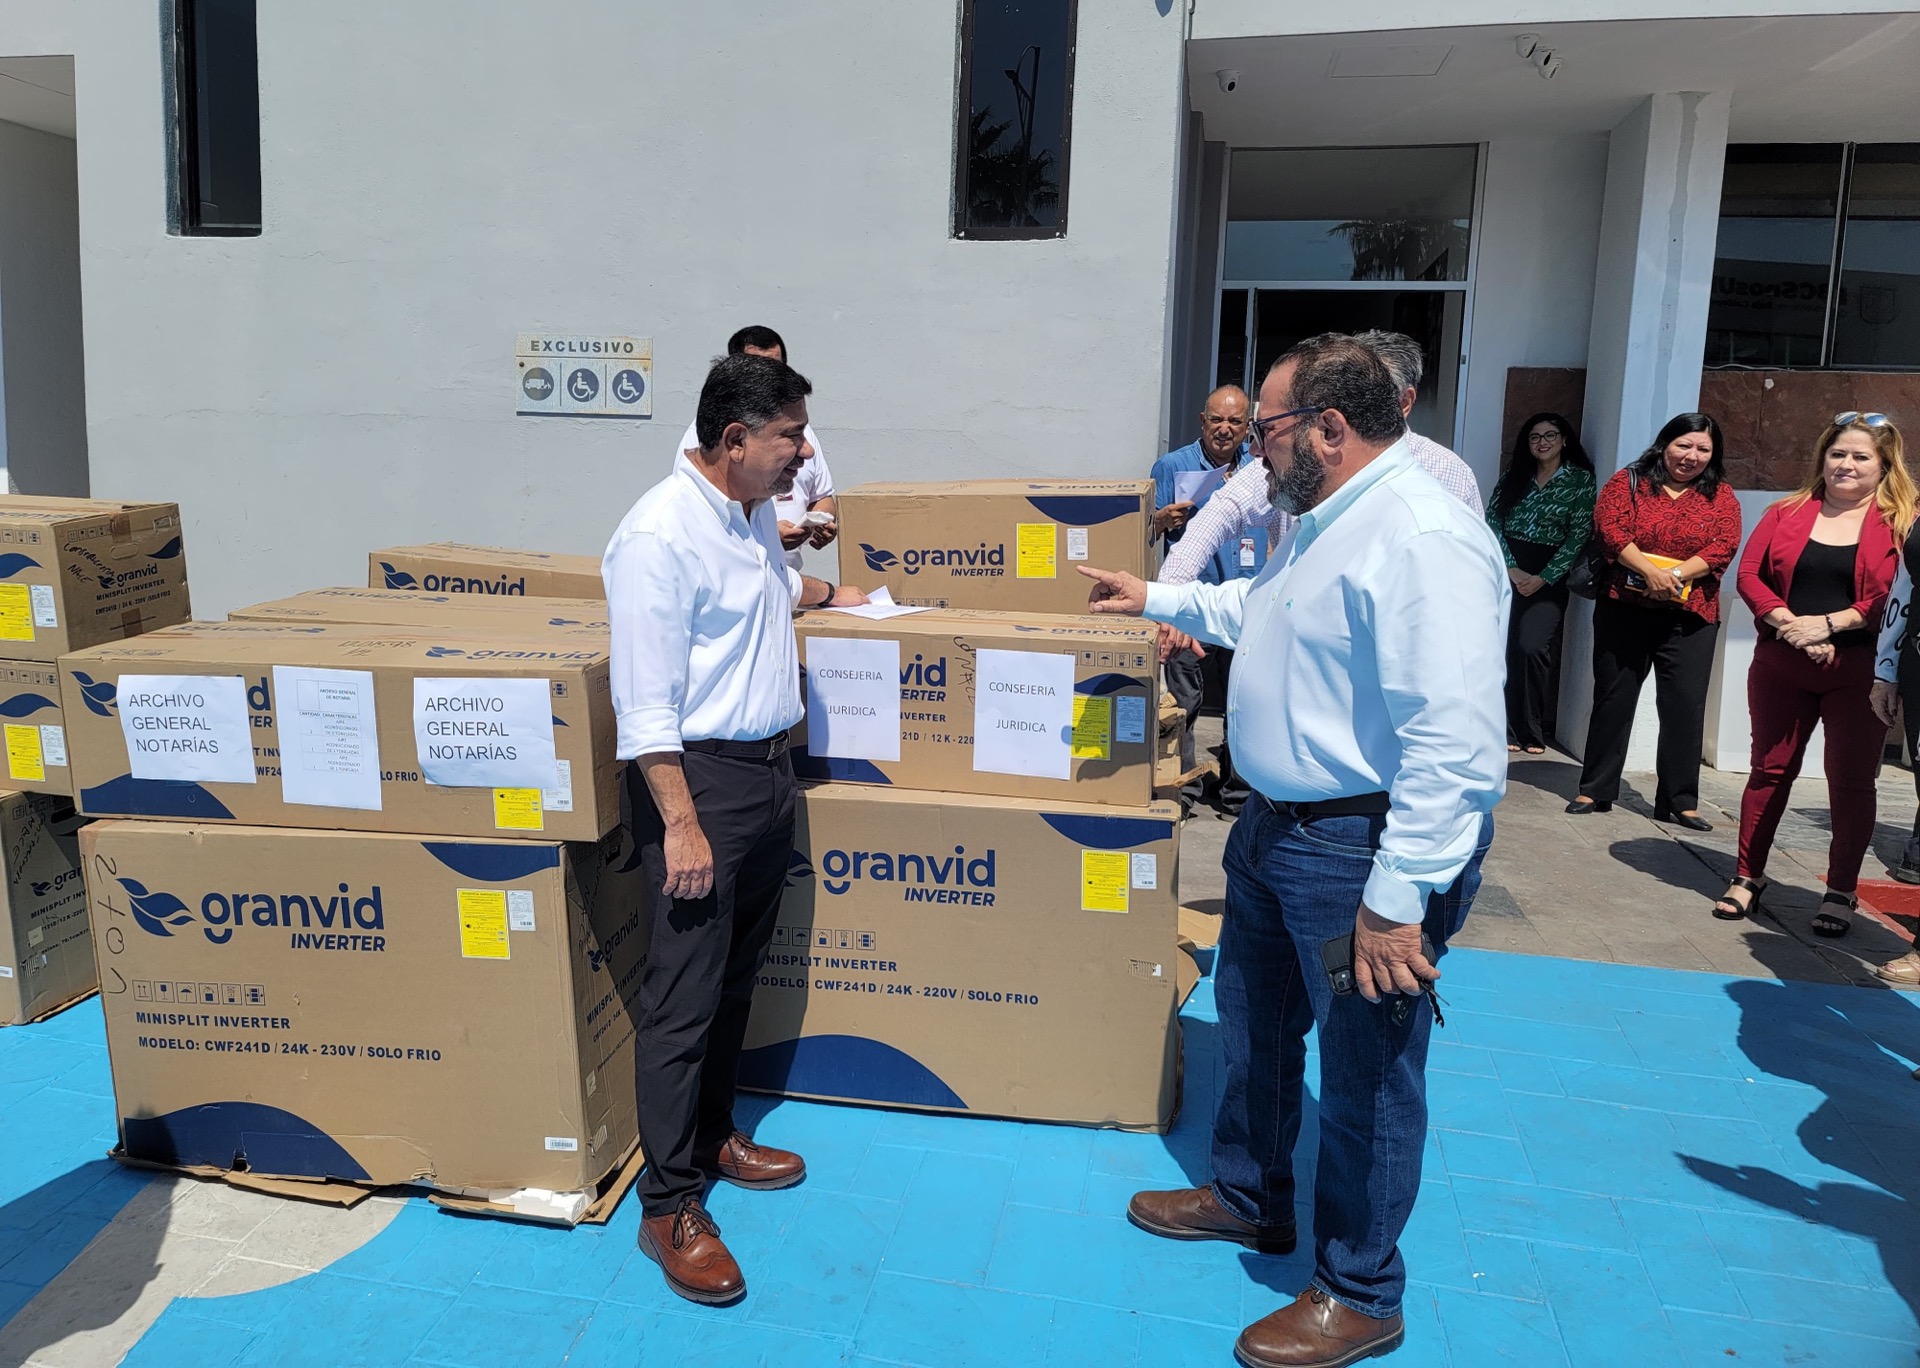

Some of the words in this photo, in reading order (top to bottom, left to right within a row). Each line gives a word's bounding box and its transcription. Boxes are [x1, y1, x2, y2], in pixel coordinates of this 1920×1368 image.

[530, 340, 634, 354] EXCLUSIVO
[904, 542, 1004, 574] granvid
[117, 562, 158, 587] granvid
[951, 568, 1004, 576] INVERTER
[96, 587, 131, 601] MINISPLIT
[132, 579, 165, 592] INVERTER
[467, 649, 600, 660] granvid
[819, 668, 883, 681] CONSEJERIA
[989, 681, 1056, 697] CONSEJERIA
[129, 694, 204, 708] ARCHIVO
[425, 697, 504, 713] ARCHIVO
[828, 704, 876, 717] JURIDICA
[132, 716, 212, 731] GENERAL
[427, 721, 510, 737] GENERAL
[996, 719, 1046, 734] JURIDICA
[136, 736, 219, 754] NOTARÍAS
[429, 743, 517, 760] NOTARÍAS
[395, 771, 418, 781] FRIO
[823, 845, 996, 895] granvid
[904, 887, 996, 906] INVERTER
[31, 896, 71, 919] MINISPLIT
[201, 882, 384, 944] granvid
[291, 934, 386, 951] INVERTER
[605, 907, 639, 963] granvid
[825, 958, 897, 971] INVERTER
[814, 980, 876, 993] CWF241D
[880, 984, 884, 993] /
[887, 984, 912, 995] 24K
[924, 987, 957, 999] 220V
[960, 989, 964, 999] /
[968, 990, 1002, 1002] SOLO
[1006, 993, 1039, 1004] FRIO
[136, 1012, 209, 1027] MINISPLIT
[214, 1016, 290, 1029] INVERTER
[139, 1036, 200, 1050] MODELO:
[205, 1040, 270, 1053] CWF241D
[274, 1042, 278, 1054] /
[282, 1043, 309, 1054] 24K
[321, 1044, 356, 1056] 230V
[360, 1046, 364, 1057] /
[368, 1047, 402, 1059] SOLO
[408, 1048, 441, 1060] FRIO
